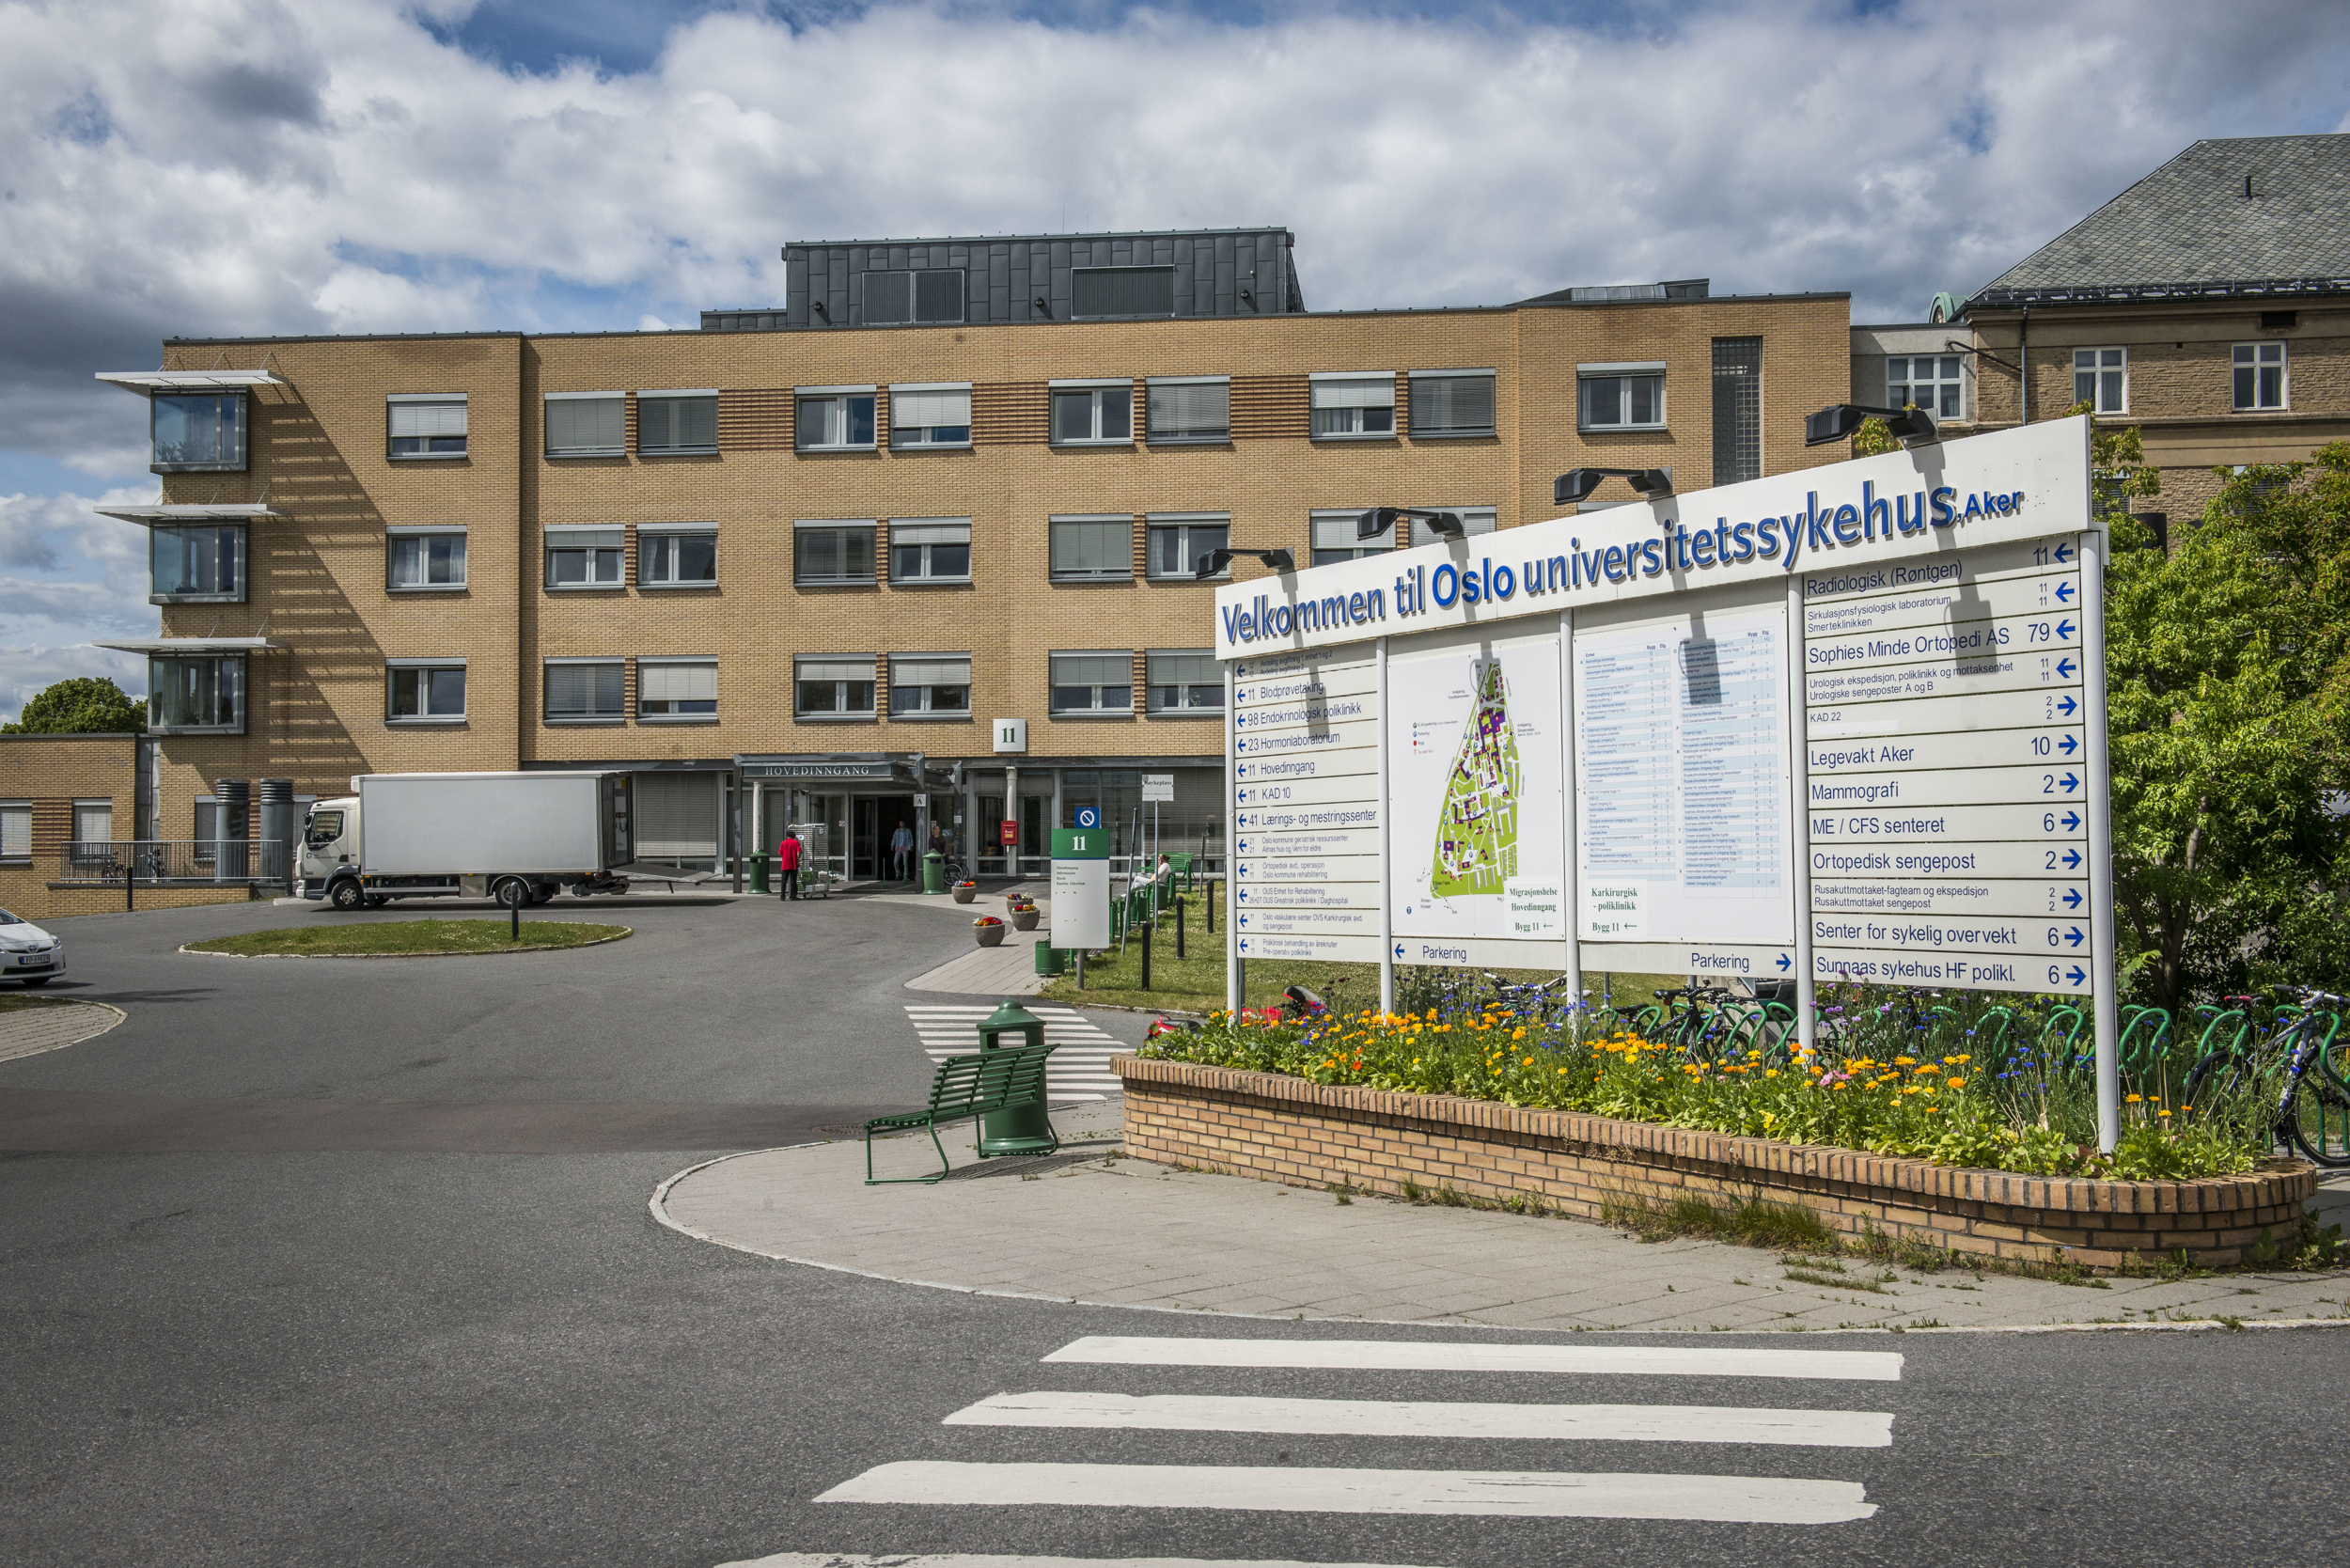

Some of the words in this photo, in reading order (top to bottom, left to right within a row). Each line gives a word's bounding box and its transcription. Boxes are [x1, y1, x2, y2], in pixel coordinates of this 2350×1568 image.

[1807, 568, 1886, 596] Radiologisk
[1890, 559, 1963, 588] (Røntgen)
[2033, 547, 2048, 566] 11
[1222, 595, 1385, 643] Velkommen
[1394, 566, 1425, 614] til
[1432, 557, 1515, 606] Oslo
[1808, 602, 1897, 621] Sirkulasjonsfysiologisk
[1899, 595, 1951, 610] laboratorium
[2039, 583, 2047, 593] 11
[1808, 618, 1872, 633] Smerteklinikken
[2039, 596, 2047, 606] 11
[1810, 645, 1864, 666] Sophies
[1869, 639, 1910, 657] Minde
[1915, 631, 1982, 653] Ortopedi
[1986, 627, 2010, 646] AS
[2028, 622, 2049, 642] 79
[1810, 677, 1845, 689] Urologisk
[1847, 673, 1896, 685] ekspedisjon,
[1899, 668, 1937, 682] poliklinikk
[1940, 669, 1950, 679] og
[1953, 662, 2013, 675] mottaksenhet
[2041, 658, 2049, 668] 11
[1247, 688, 1255, 701] 11
[1261, 681, 1324, 699] Blodprøvetaking
[1810, 687, 1850, 701] Urologiske
[1852, 684, 1903, 698] sengeposter
[1905, 683, 1912, 693] A
[1914, 684, 1925, 694] og
[1927, 682, 1934, 691] B
[2041, 672, 2050, 682] 11
[1247, 713, 1259, 726] 98
[1261, 707, 1322, 725] Endokrinologisk
[1324, 702, 1361, 720] poliklinikk
[1810, 713, 1828, 722] KAD
[1831, 712, 1841, 721] 22
[2046, 696, 2052, 706] 2
[2046, 710, 2053, 720] 2
[1001, 728, 1016, 743] 11
[1248, 738, 1259, 751] 23
[1261, 731, 1340, 749] Hormonlaboratorium
[1811, 747, 1874, 769] Legevakt
[1880, 745, 1914, 762] Aker
[2031, 736, 2050, 755] 10
[765, 766, 870, 776] HOVEDINNGANG
[1248, 763, 1255, 776] 11
[1261, 761, 1314, 775] Hovedinngang
[1248, 789, 1255, 801] 11
[1262, 788, 1280, 800] KAD
[1282, 787, 1291, 798] 10
[1812, 781, 1898, 802] Mammografi
[2044, 775, 2054, 793] 2
[1249, 814, 1258, 826] 41
[1262, 813, 1296, 827] Lærings-
[1298, 814, 1308, 826] og
[1310, 809, 1376, 826] mestringssenter
[1813, 819, 1835, 834] ME
[1849, 818, 1879, 834] CFS
[1885, 817, 1945, 833] senteret
[2044, 813, 2055, 832] 6
[1073, 836, 1087, 851] 11
[1814, 853, 1890, 872] Ortopedisk
[1896, 853, 1975, 873] sengepost
[2045, 851, 2057, 870] 2
[1297, 870, 1327, 879] rehabilitering
[1510, 887, 1558, 898] Migrasjonshelse
[1591, 888, 1638, 899] Karkirurgisk
[1815, 885, 1920, 897] Rusakuttmottaket-fagteam
[1923, 887, 1934, 898] og
[1936, 886, 1988, 898] ekspedisjon
[2049, 887, 2055, 897] 2
[1295, 897, 1316, 905] poliklinikk
[1321, 897, 1348, 905] Daghospital
[1511, 903, 1557, 913] Hovedinngang
[1598, 902, 1637, 912] poliklinikk
[1815, 897, 1884, 907] Rusakuttmottaket
[1887, 899, 1931, 910] sengepost
[2049, 902, 2055, 911] 2
[1515, 922, 1530, 933] Bygg
[1533, 922, 1540, 931] 11
[1592, 923, 1610, 933] Bygg
[1612, 923, 1620, 932] 11
[1816, 922, 1862, 938] Senter
[1867, 923, 1887, 939] for
[1892, 924, 1942, 946] sykelig
[1947, 927, 2016, 944] overvekt
[2048, 927, 2059, 947] 6
[1263, 948, 1290, 956] Pre-operativ
[1292, 949, 1312, 957] poliklinikk
[1284, 939, 1308, 948] behandling
[1422, 945, 1467, 963] Parkering
[1691, 952, 1749, 973] Parkering
[1816, 956, 1877, 975] Sunnaas
[1882, 960, 1941, 980] sykehus
[1946, 962, 1967, 979] HF
[1972, 964, 2015, 984] polikl.
[2048, 965, 2060, 984] 6
